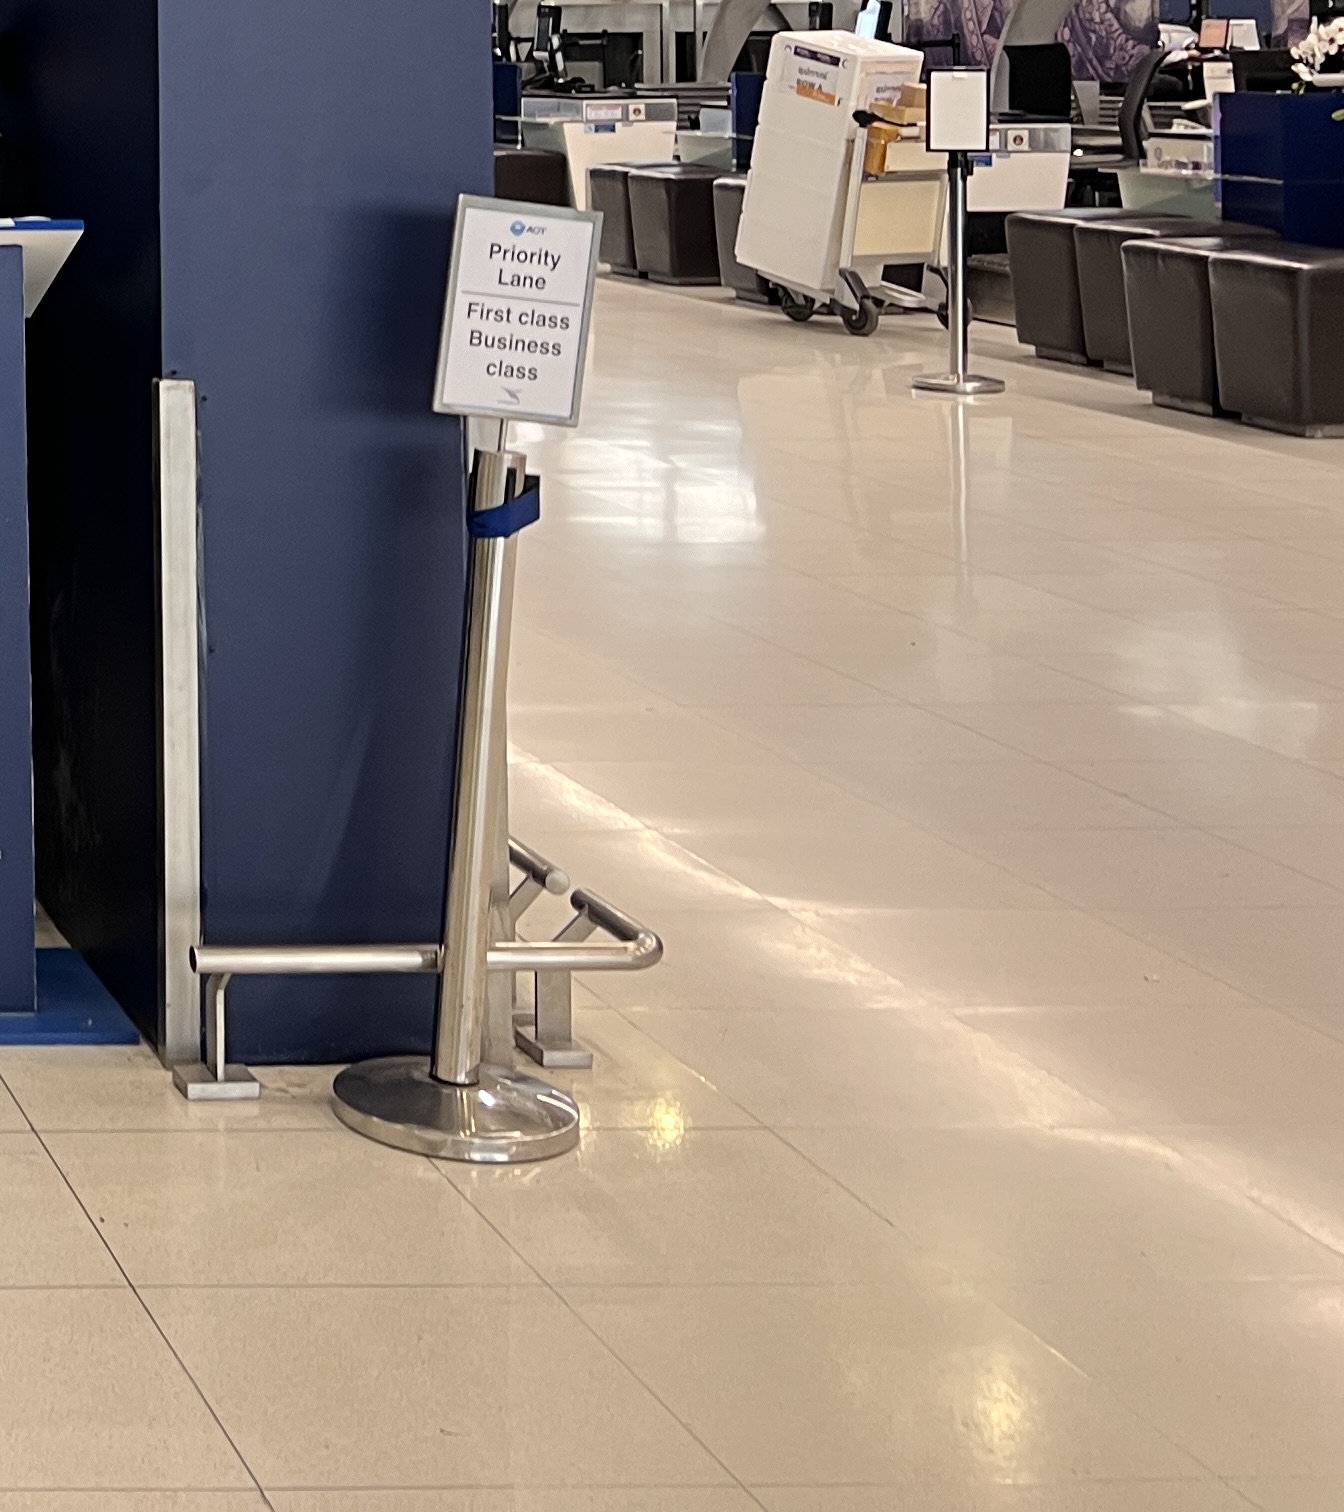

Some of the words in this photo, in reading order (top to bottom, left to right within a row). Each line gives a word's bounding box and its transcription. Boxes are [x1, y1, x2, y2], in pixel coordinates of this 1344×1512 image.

[489, 242, 561, 272] Priority
[498, 268, 547, 291] Lane
[467, 301, 512, 324] First
[518, 309, 570, 331] class
[469, 329, 562, 357] Business
[486, 359, 538, 381] class
